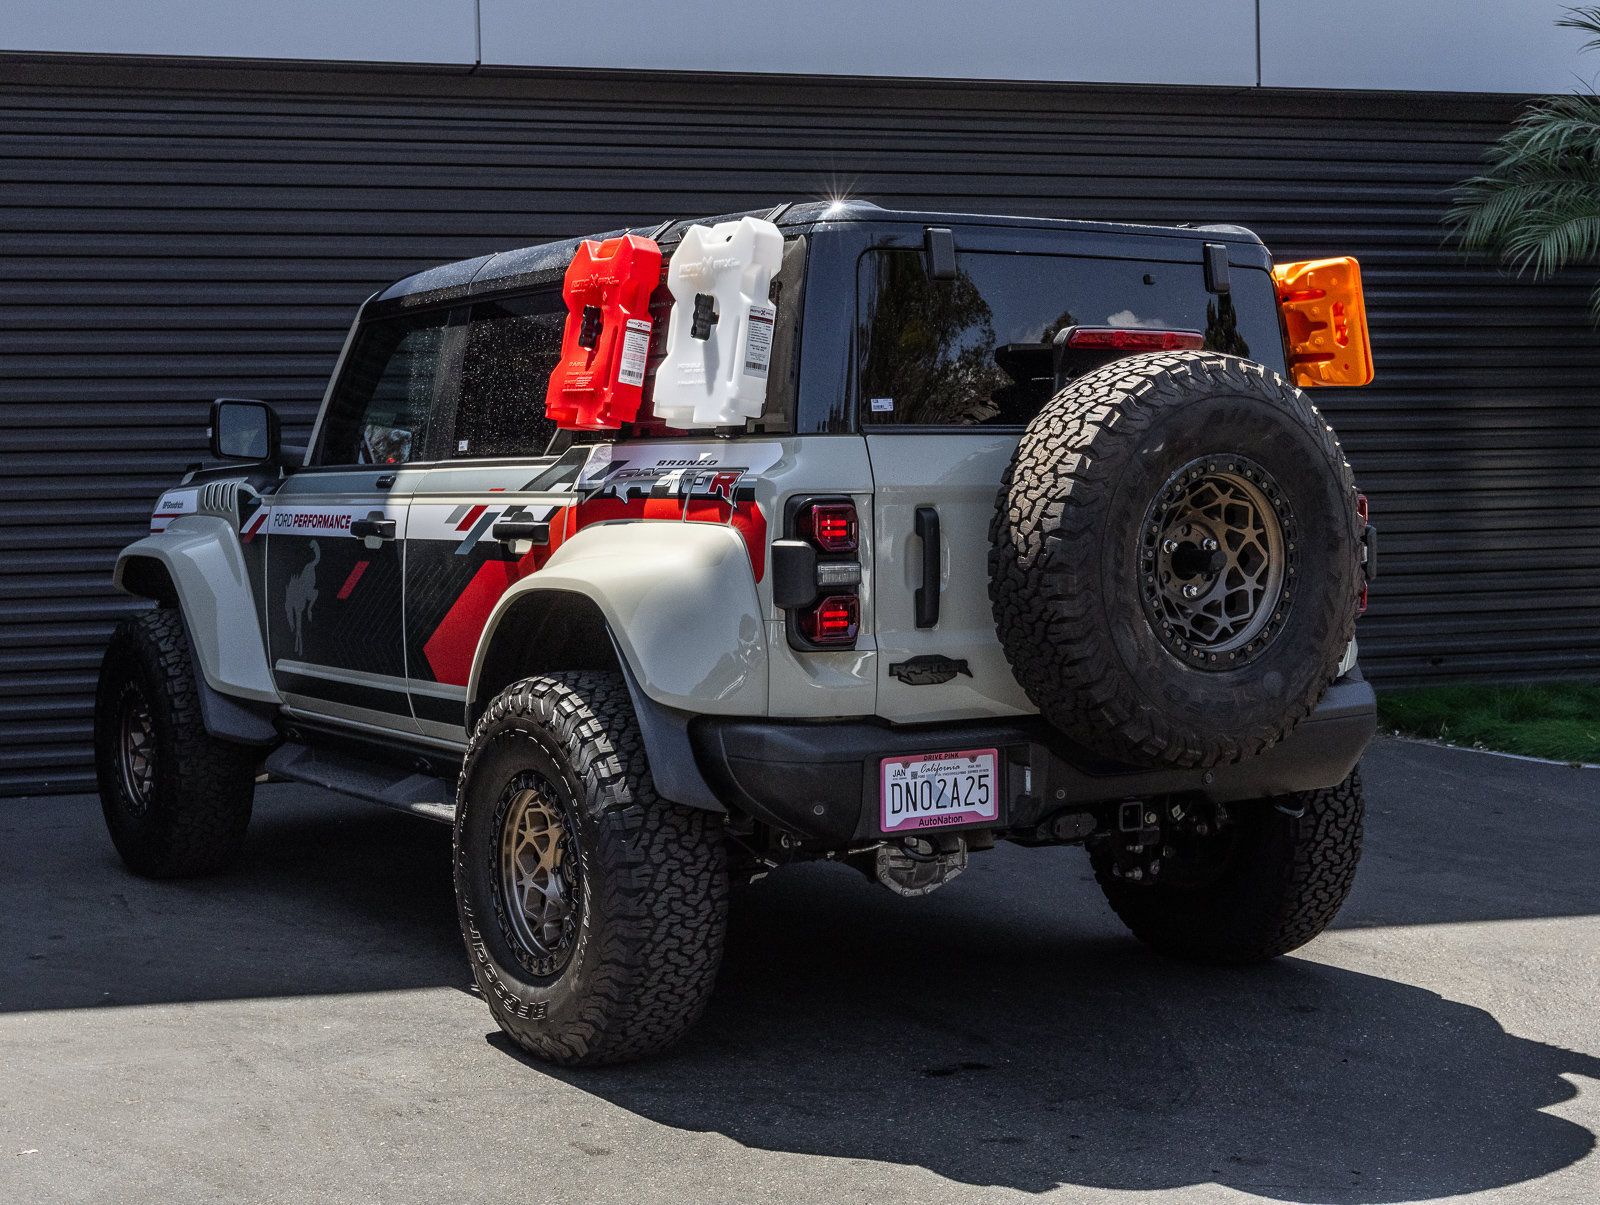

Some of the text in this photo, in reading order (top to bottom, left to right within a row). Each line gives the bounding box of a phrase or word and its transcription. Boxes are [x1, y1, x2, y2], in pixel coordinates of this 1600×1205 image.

[603, 467, 749, 509] RAPTOR
[162, 501, 184, 509] BFGoodrich
[273, 513, 351, 530] FORD PERFORMANCE
[923, 753, 943, 761] DRIVE
[892, 768, 906, 778] JAN
[920, 762, 961, 777] California
[890, 774, 990, 815] DN02A25
[918, 815, 963, 827] AutoNation
[464, 893, 549, 1020] BFGoodri
